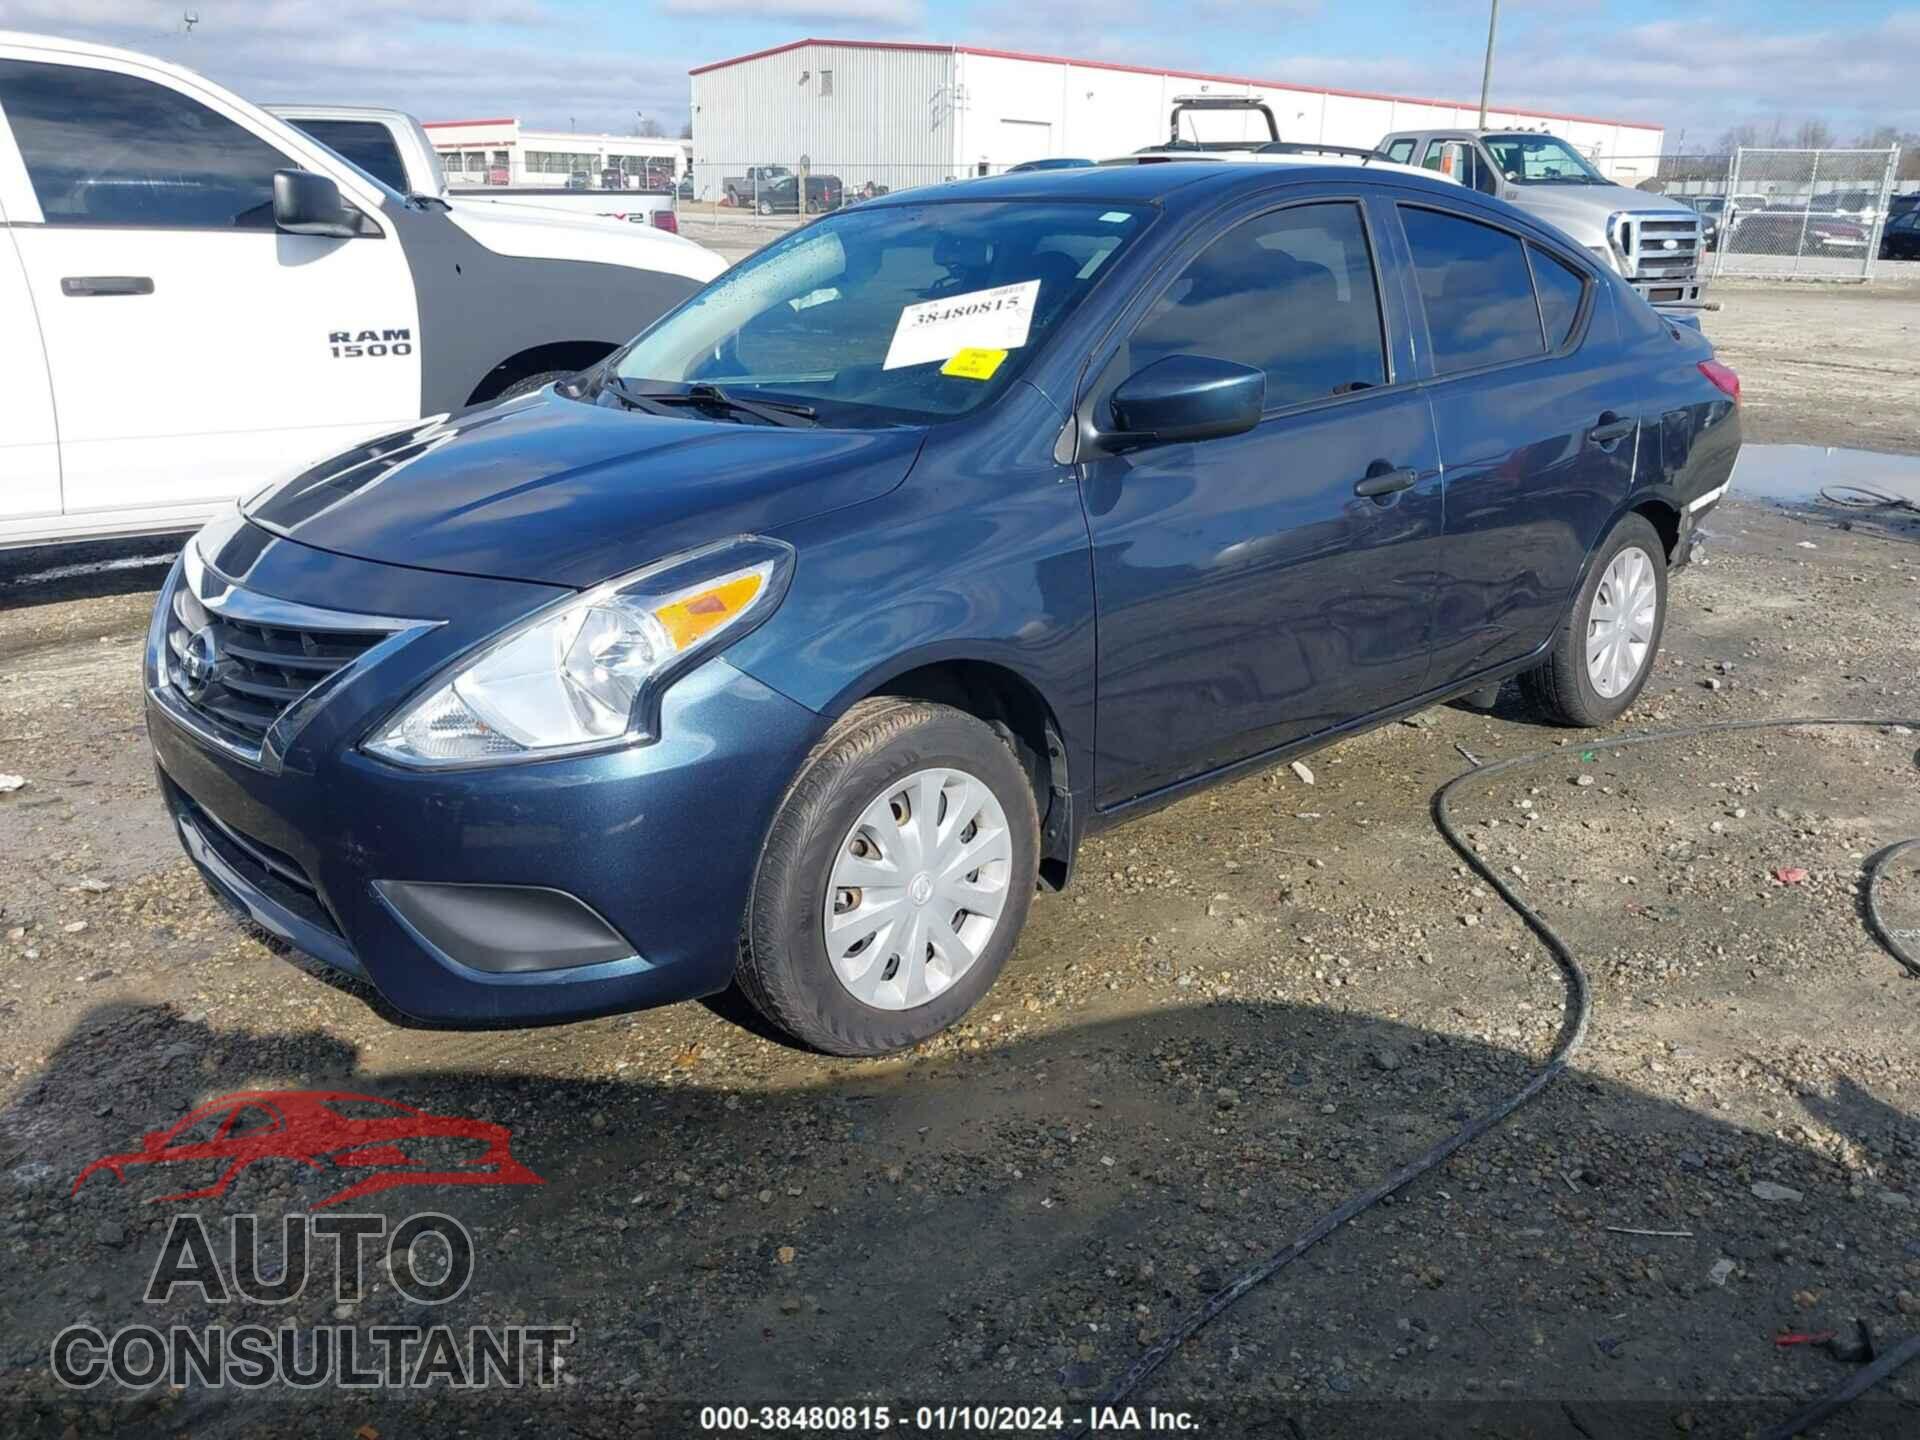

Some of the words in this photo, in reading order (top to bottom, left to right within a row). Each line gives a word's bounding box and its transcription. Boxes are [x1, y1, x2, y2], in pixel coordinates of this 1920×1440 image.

[912, 296, 1019, 327] 38480815
[329, 328, 410, 344] RAM
[331, 343, 412, 359] 1500
